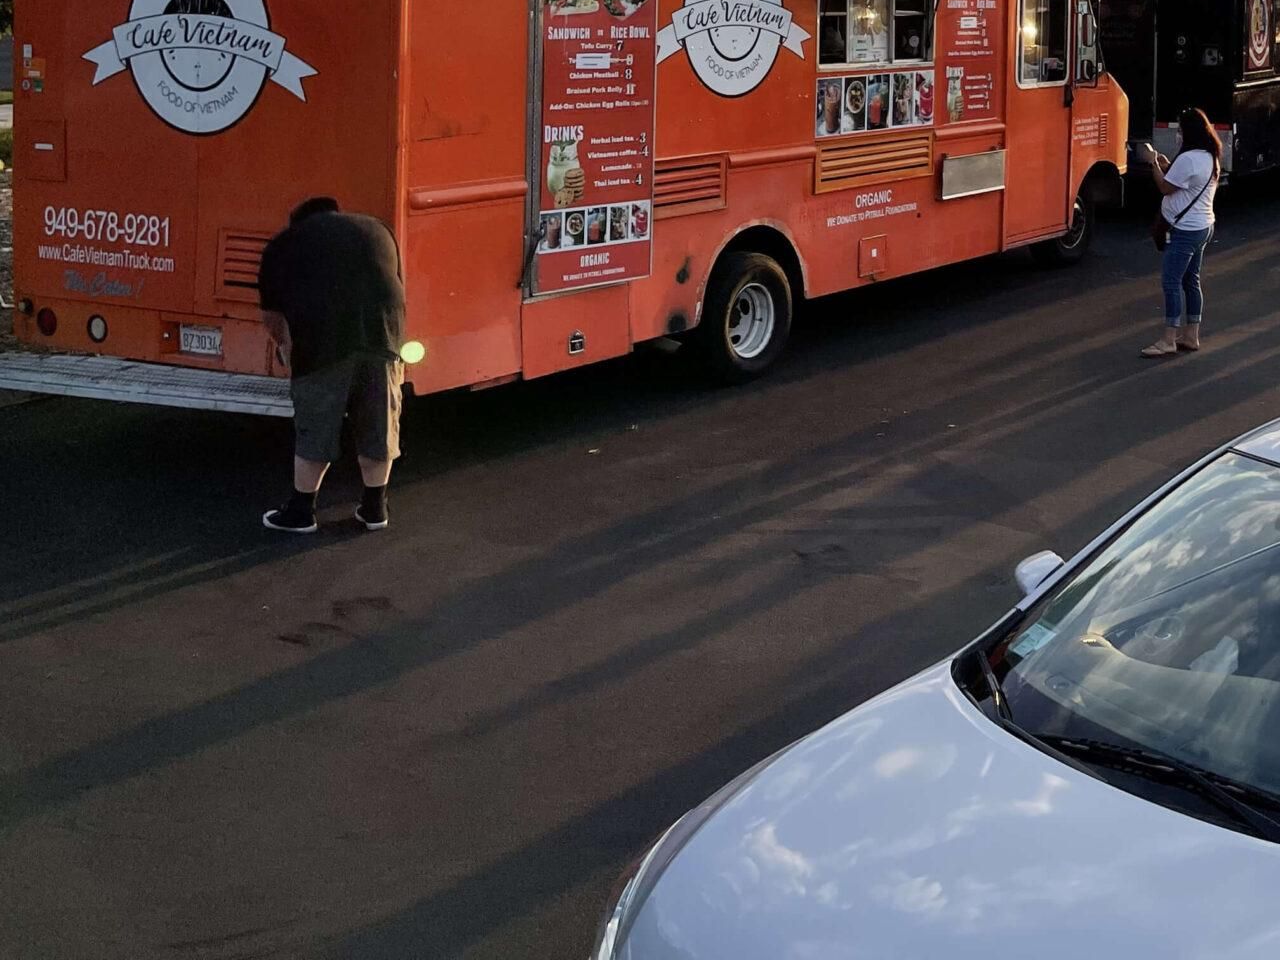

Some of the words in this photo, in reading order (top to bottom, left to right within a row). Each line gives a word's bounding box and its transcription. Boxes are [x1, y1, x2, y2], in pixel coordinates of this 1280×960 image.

[683, 4, 720, 30] Cafe
[721, 0, 785, 29] Vietnam
[127, 20, 175, 49] Cafe
[177, 15, 273, 58] Vietnam
[548, 26, 590, 40] SANDWICH
[611, 25, 628, 39] RICE
[629, 25, 650, 39] BOWL
[595, 42, 613, 50] Curry
[705, 55, 724, 77] FOOD
[724, 69, 735, 80] OF
[735, 53, 763, 80] VIETNAM
[157, 79, 184, 109] FOOD
[184, 100, 199, 114] OF
[200, 85, 239, 115] VIETNAM
[544, 124, 584, 143] DRINKS
[855, 189, 893, 208] ORGANIC
[44, 205, 170, 247] 949-678-9281
[38, 243, 174, 272] www.CafeVietnamTruck.com
[580, 252, 610, 268] ORGANIC
